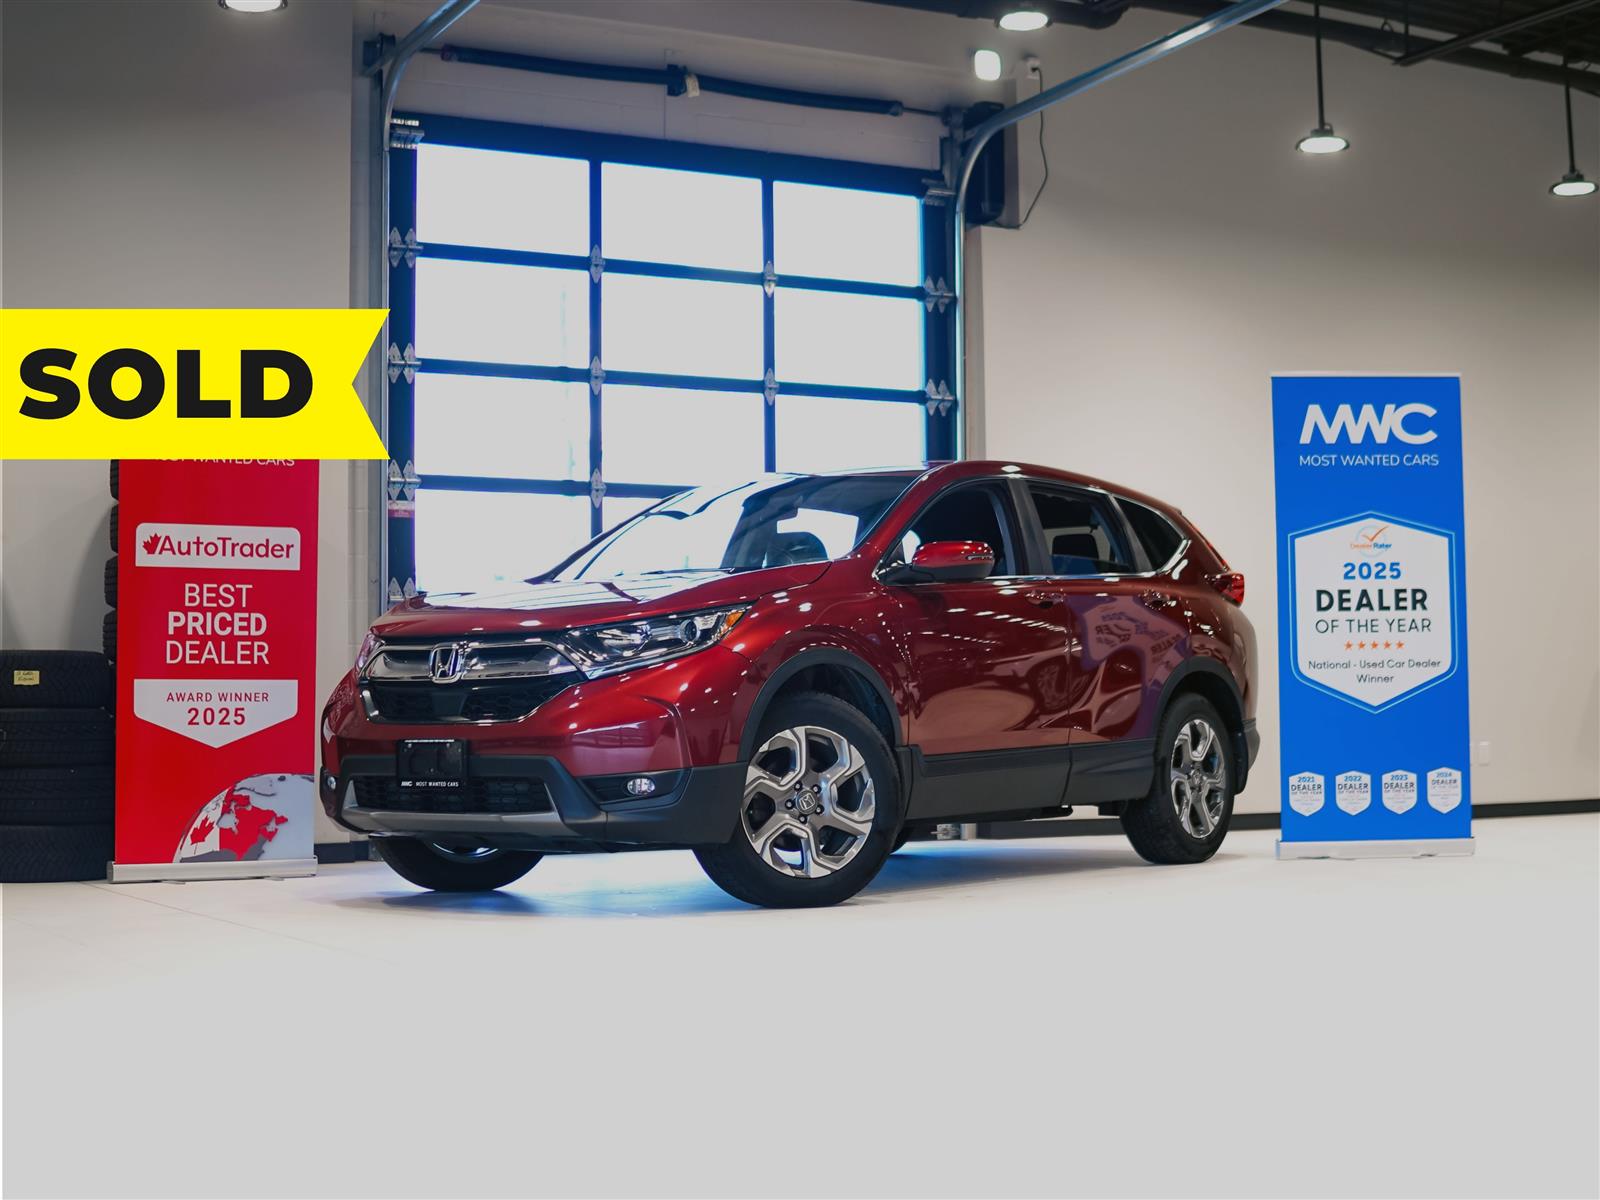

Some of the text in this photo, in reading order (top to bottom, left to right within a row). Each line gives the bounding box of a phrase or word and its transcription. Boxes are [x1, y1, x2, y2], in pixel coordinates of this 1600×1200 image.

[1299, 403, 1438, 444] MWC
[1299, 454, 1439, 467] MOST WANTED CARS
[159, 534, 294, 559] AutoTrader
[1343, 562, 1402, 580] 2025
[184, 583, 253, 608] BEST
[1316, 588, 1428, 612] DEALER
[168, 611, 267, 637] PRICED
[1315, 618, 1432, 634] OF THE YEAR
[166, 641, 270, 665] DEALER
[1308, 660, 1351, 670] National
[1359, 660, 1385, 669] Used
[1387, 660, 1406, 669] Car
[1408, 659, 1441, 669] Dealer
[1356, 673, 1395, 684] Winner
[166, 692, 270, 703] AWARD WINNER
[187, 708, 247, 726] 2025
